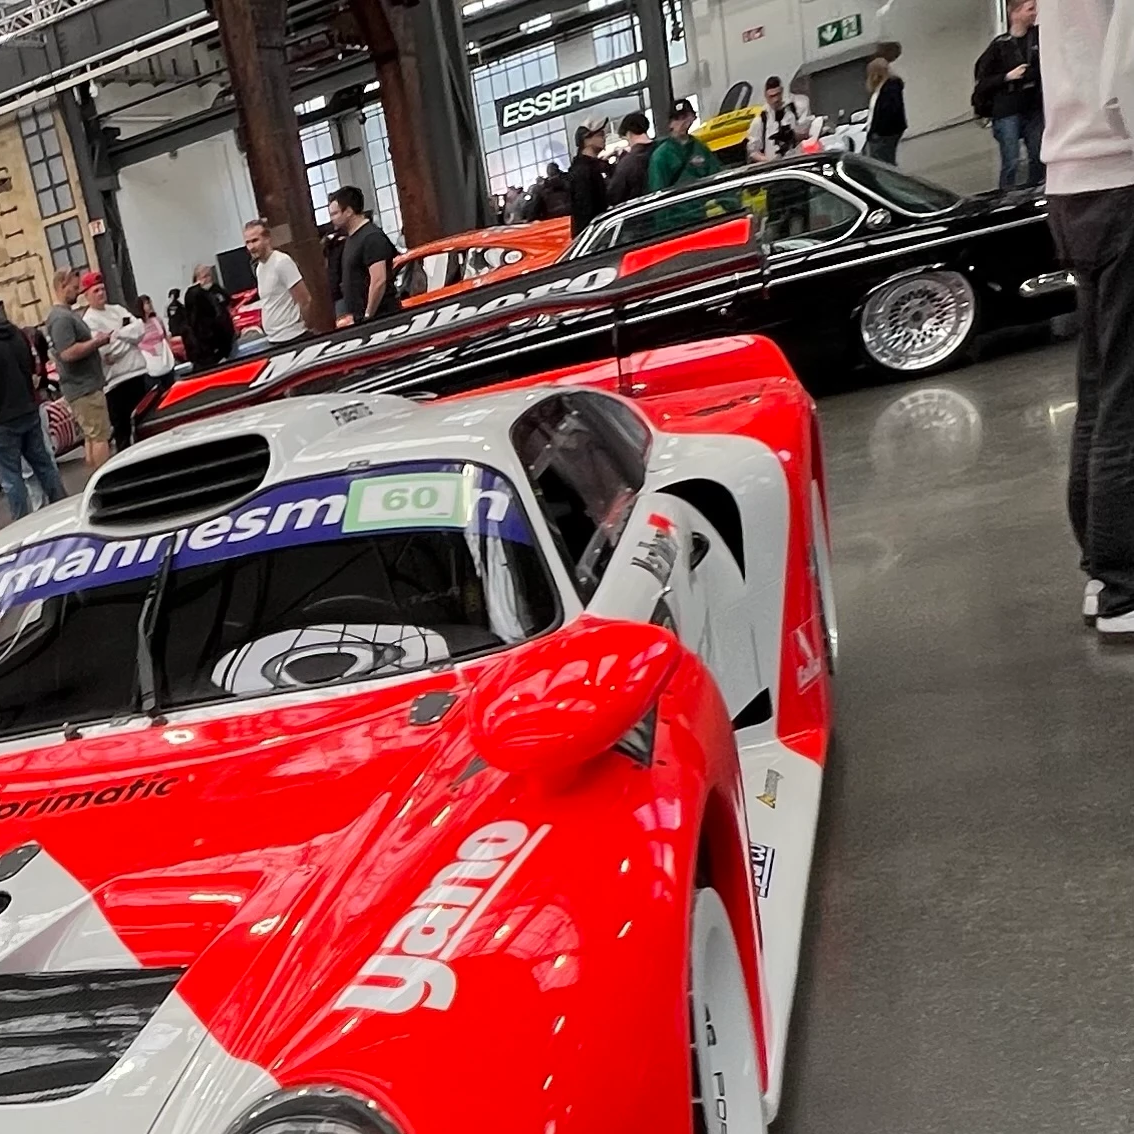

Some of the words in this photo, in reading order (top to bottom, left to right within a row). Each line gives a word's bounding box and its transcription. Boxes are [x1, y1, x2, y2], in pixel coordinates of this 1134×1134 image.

[503, 80, 585, 127] ESSER
[249, 267, 618, 388] Marlboro
[382, 486, 439, 511] 60
